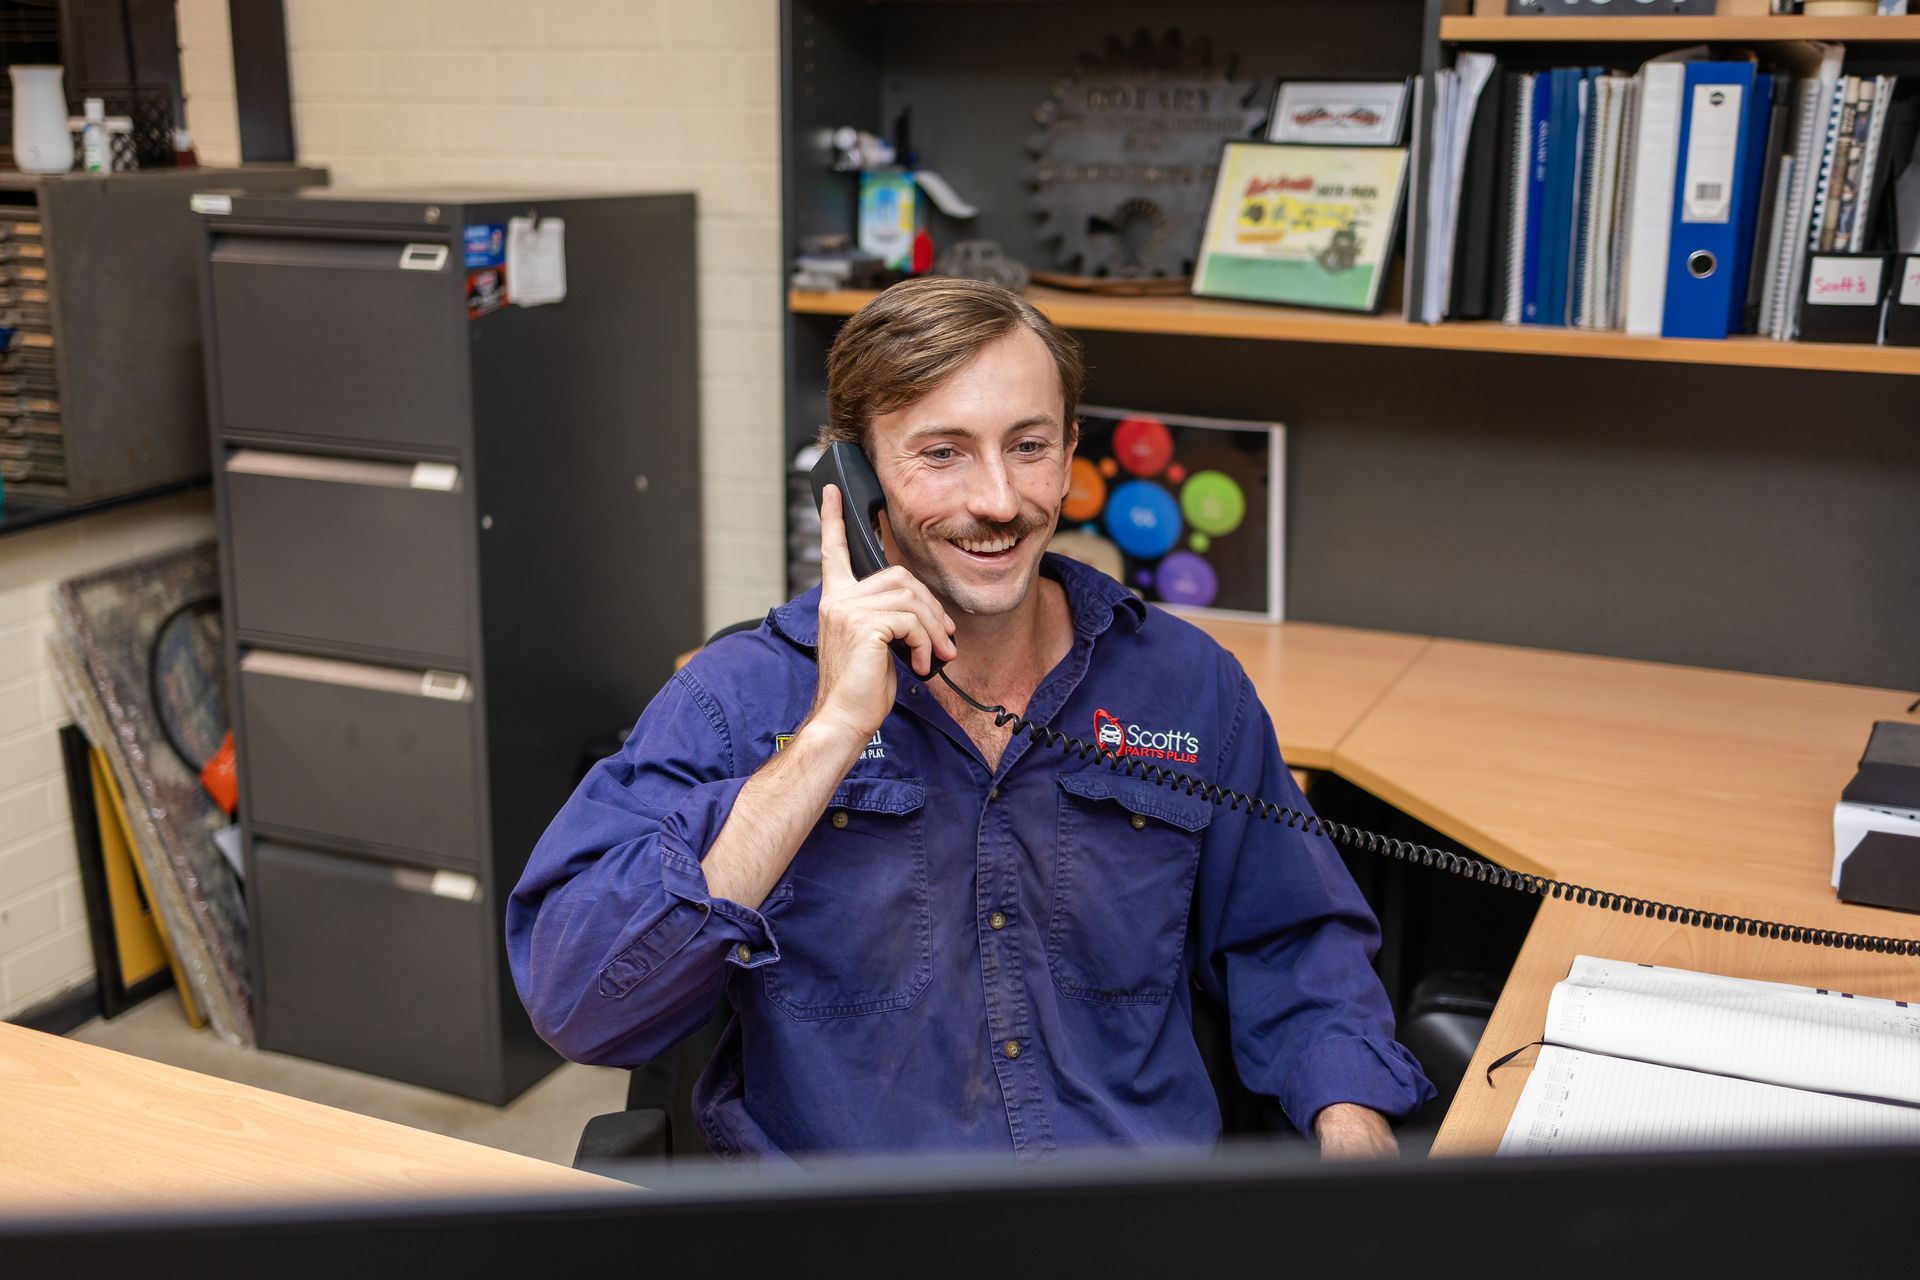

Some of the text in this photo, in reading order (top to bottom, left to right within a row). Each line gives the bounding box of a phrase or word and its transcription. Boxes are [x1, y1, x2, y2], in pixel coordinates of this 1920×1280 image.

[1126, 724, 1199, 754] Scott's
[1125, 746, 1199, 764] PARTS PLUS
